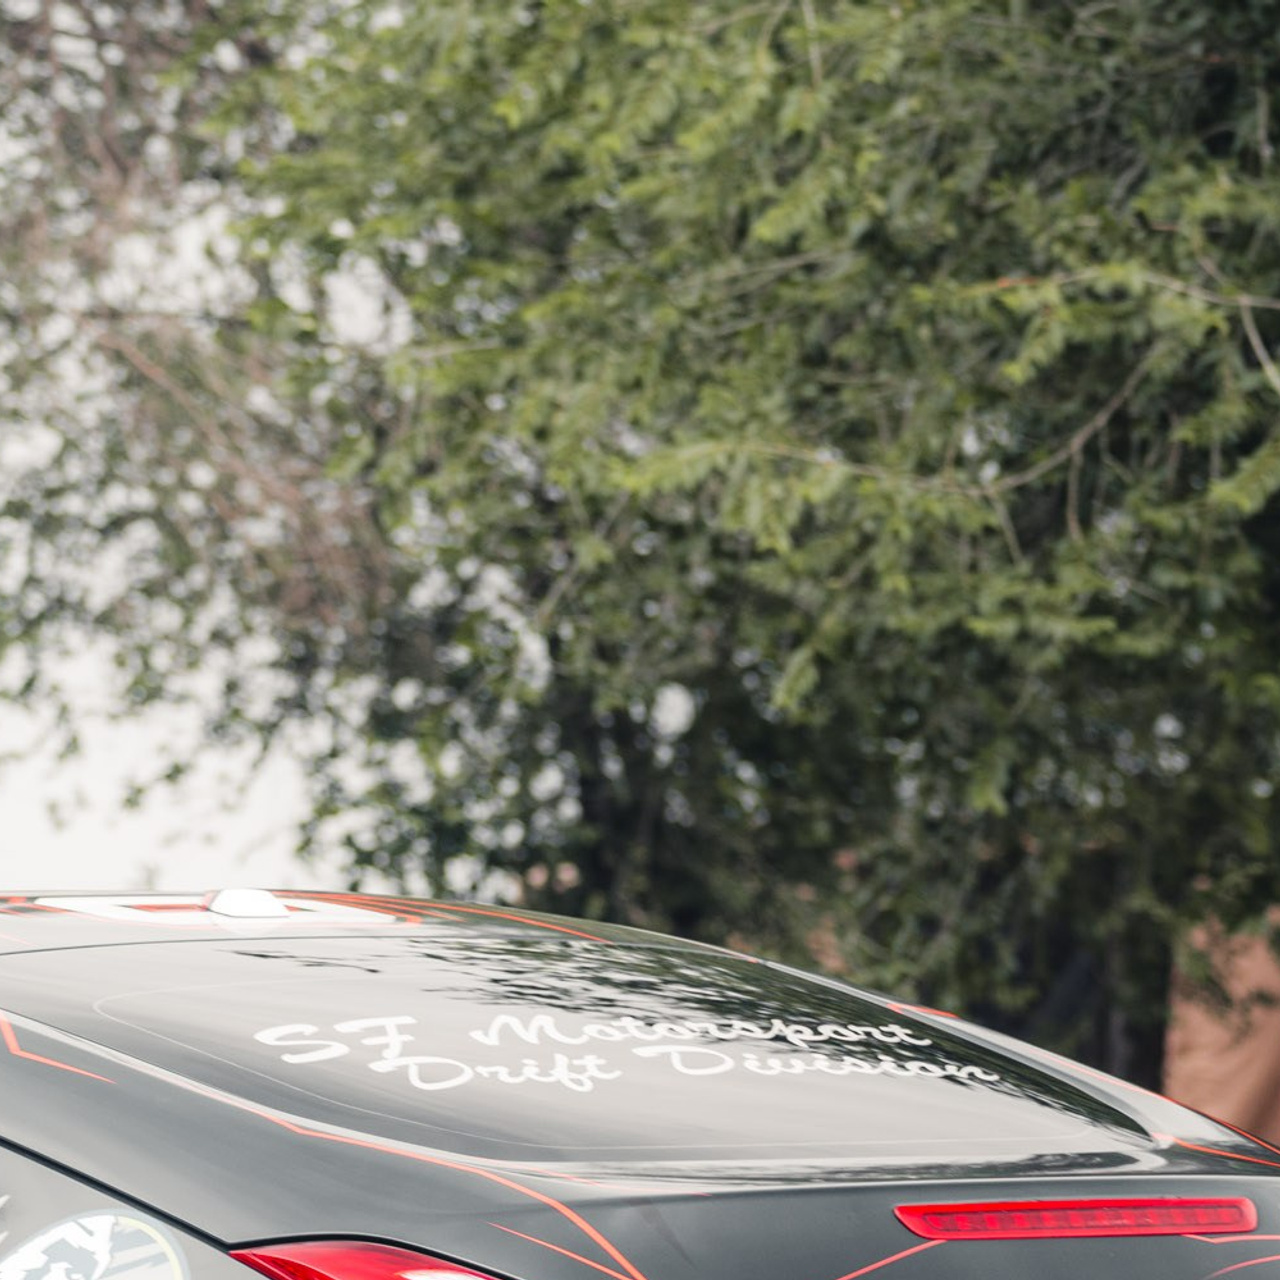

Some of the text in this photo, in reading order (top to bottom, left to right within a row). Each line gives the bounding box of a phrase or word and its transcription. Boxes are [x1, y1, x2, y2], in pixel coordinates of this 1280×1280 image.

[253, 1014, 933, 1064] SF Motorsport
[367, 1044, 1001, 1093] Drift Division
